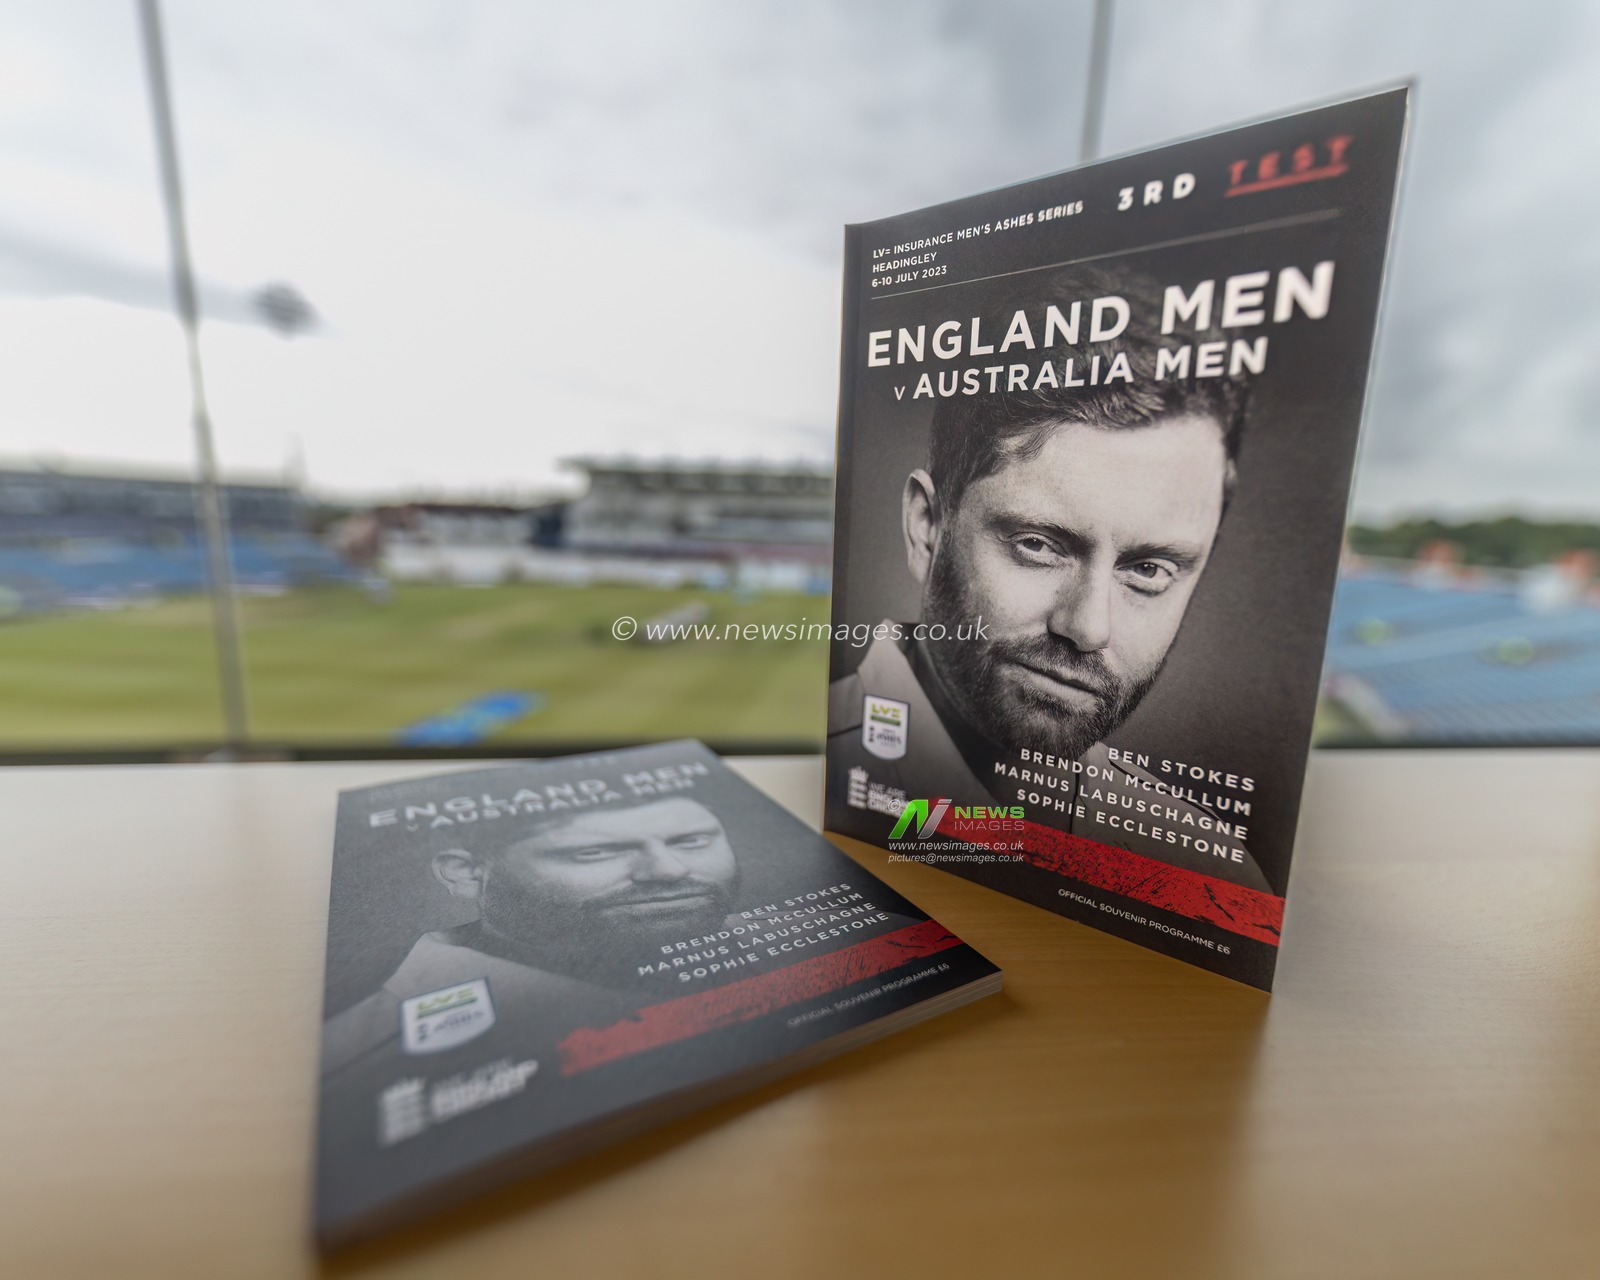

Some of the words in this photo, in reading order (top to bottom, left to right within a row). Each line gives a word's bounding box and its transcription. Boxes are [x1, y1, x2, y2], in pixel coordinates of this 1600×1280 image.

[1117, 173, 1196, 211] 3RD
[1227, 135, 1353, 187] TEST
[873, 247, 891, 259] LV=
[893, 232, 954, 254] INSURANCE
[956, 223, 991, 240] MEN'S
[994, 213, 1034, 232] ASHES
[1037, 200, 1084, 223] SERIES
[871, 276, 892, 288] 6-10
[895, 271, 919, 284] JULY
[922, 265, 947, 279] 2023
[872, 252, 938, 273] HEADINGLEY
[868, 295, 1131, 368] ENGLAND
[1160, 261, 1336, 335] MEN
[912, 354, 1134, 400] AUSTRALIA
[1154, 336, 1269, 382] MEN
[369, 778, 608, 828] ENGLAND
[621, 762, 710, 786] MEN
[994, 762, 1070, 792] MARNUS
[1079, 785, 1249, 840] LABUSCHAGNE
[1021, 749, 1114, 781] BRENDON
[1125, 774, 1251, 816] McCULLUM
[1108, 748, 1150, 768] BEN
[1160, 760, 1255, 792] STOKES
[430, 789, 623, 830] AUSTRALIA
[631, 778, 696, 796] MEN
[1017, 789, 1086, 818] SOPHIE
[1095, 811, 1245, 863] ECCLESTONE
[660, 921, 761, 955] BRENDON
[767, 893, 864, 925] McCULLUM
[740, 904, 777, 920] BEN
[784, 883, 852, 907] STOKES
[1058, 888, 1098, 908] OFFICIAL
[1099, 903, 1147, 926] SOUVENIR
[1149, 920, 1214, 949] PROGRAMME
[637, 945, 730, 977] MARNUS
[738, 902, 877, 950] LABUSCHAGNE
[678, 952, 760, 983] SOPHIE
[766, 913, 890, 957] ECCLESTONE
[786, 1006, 833, 1028] OFFICIAL
[834, 987, 882, 1010] SOUVENIR
[882, 967, 939, 993] PROGRAMME
